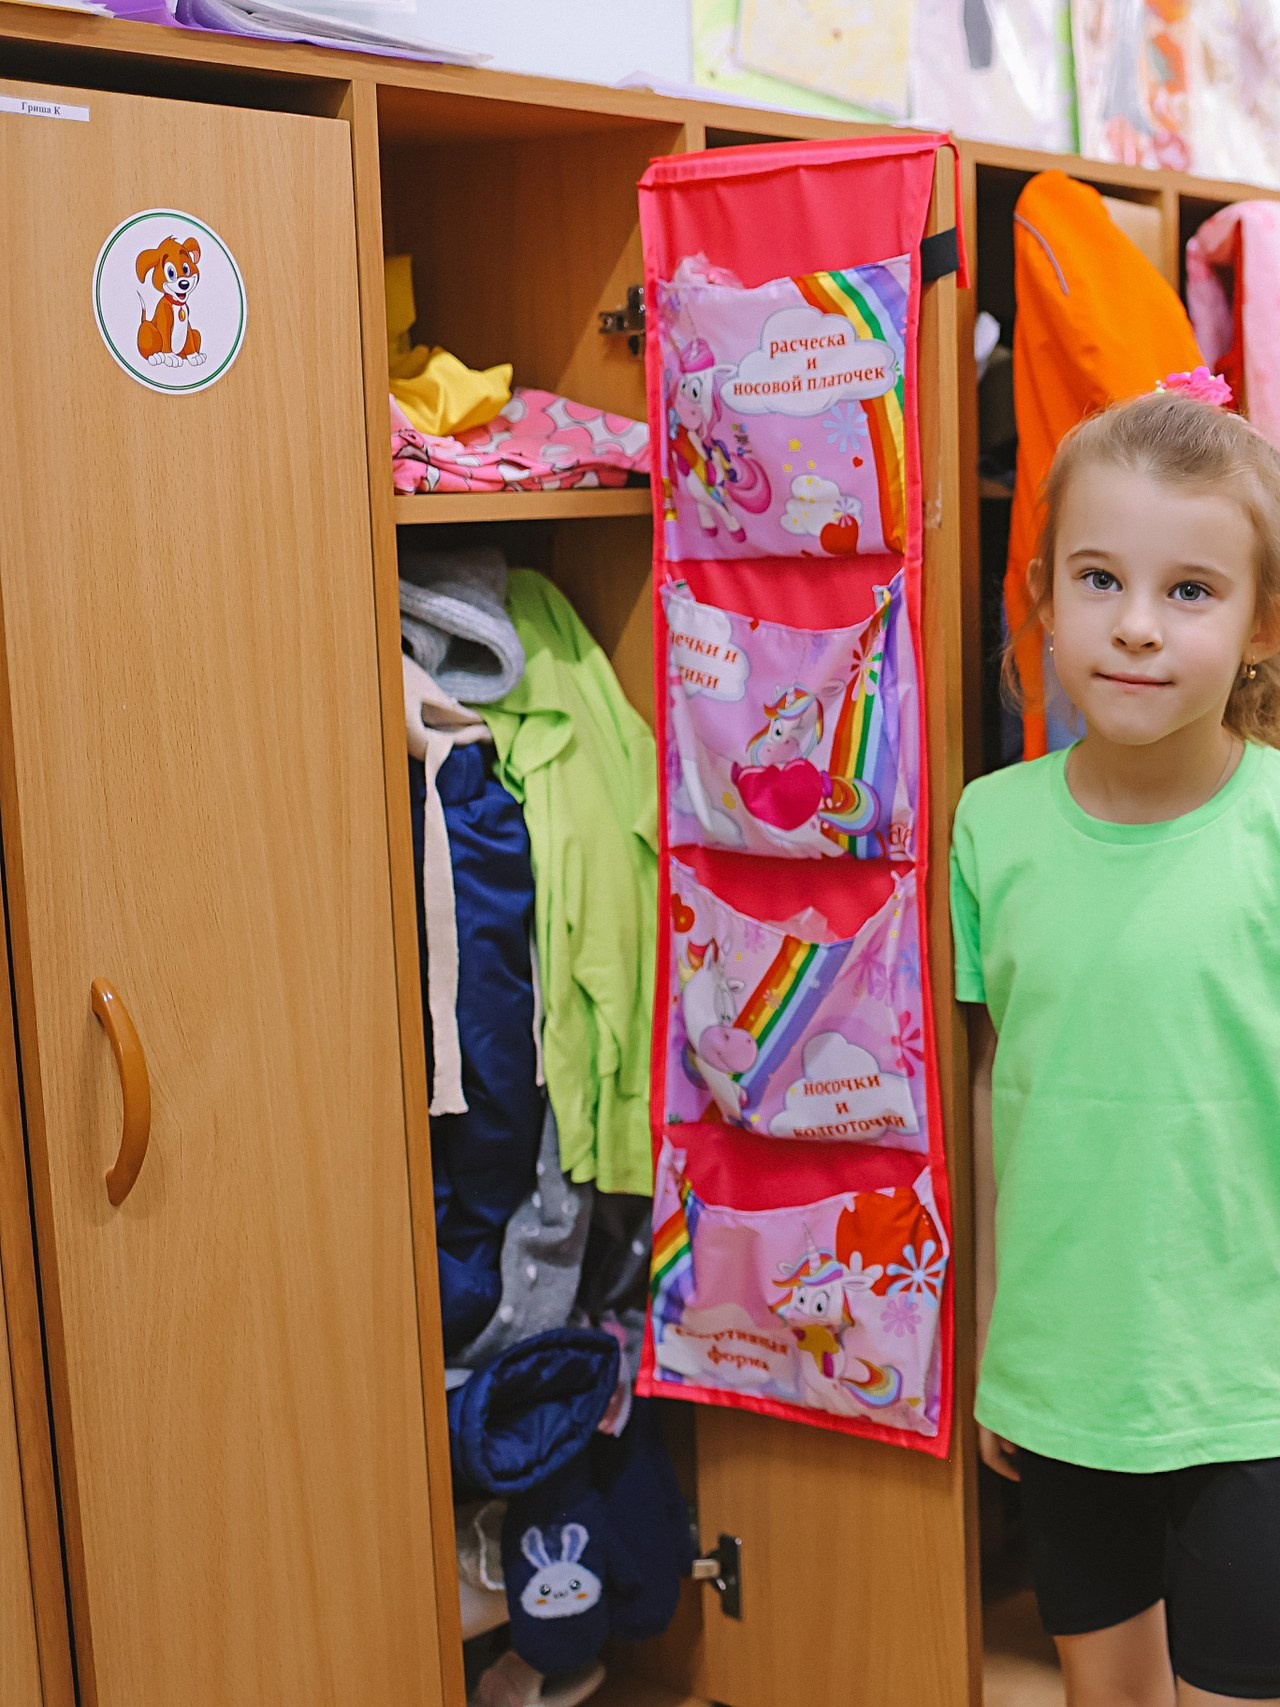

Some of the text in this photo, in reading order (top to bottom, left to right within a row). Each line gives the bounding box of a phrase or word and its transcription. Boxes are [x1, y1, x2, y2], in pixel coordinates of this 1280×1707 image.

[21, 102, 61, 115] Гриша К
[769, 333, 846, 358] расческа
[806, 357, 818, 370] и
[733, 367, 885, 395] носовой платочек
[671, 632, 738, 663] ечки и
[803, 1075, 881, 1096] носочки
[835, 1102, 849, 1115] и
[707, 1345, 770, 1371] форма
